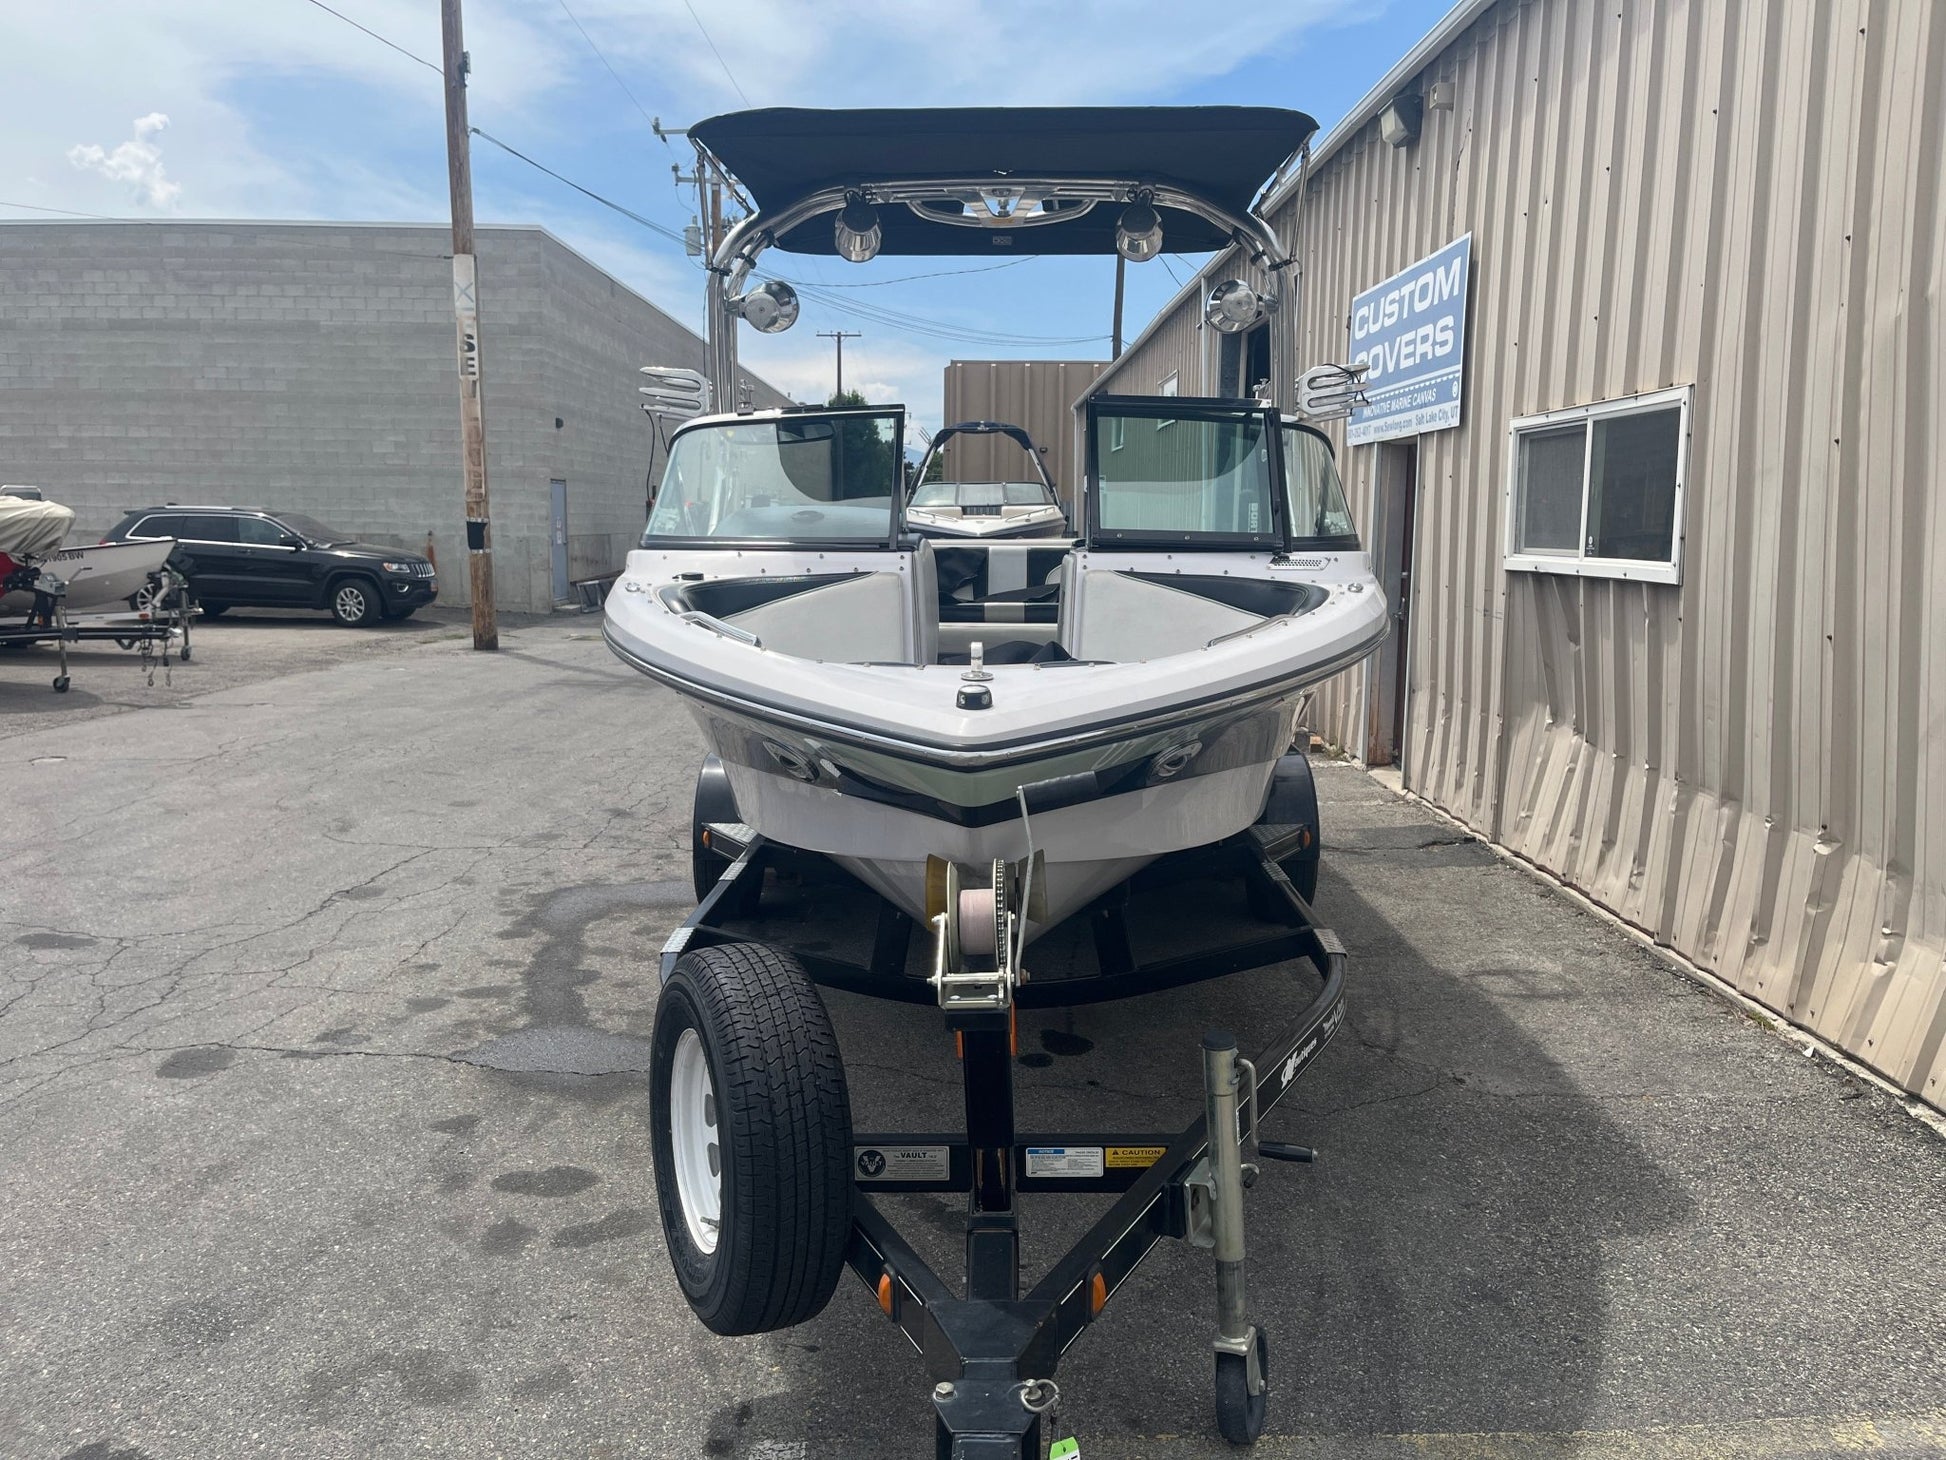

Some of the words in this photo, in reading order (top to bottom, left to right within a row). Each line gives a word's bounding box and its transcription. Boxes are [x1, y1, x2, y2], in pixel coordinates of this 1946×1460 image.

[1355, 256, 1461, 340] CUSTOM
[1391, 396, 1411, 413] MARINE
[1412, 388, 1437, 406] CANVAS
[1416, 413, 1425, 426] Salt
[1425, 410, 1437, 424] Lake
[1451, 405, 1459, 419] UT
